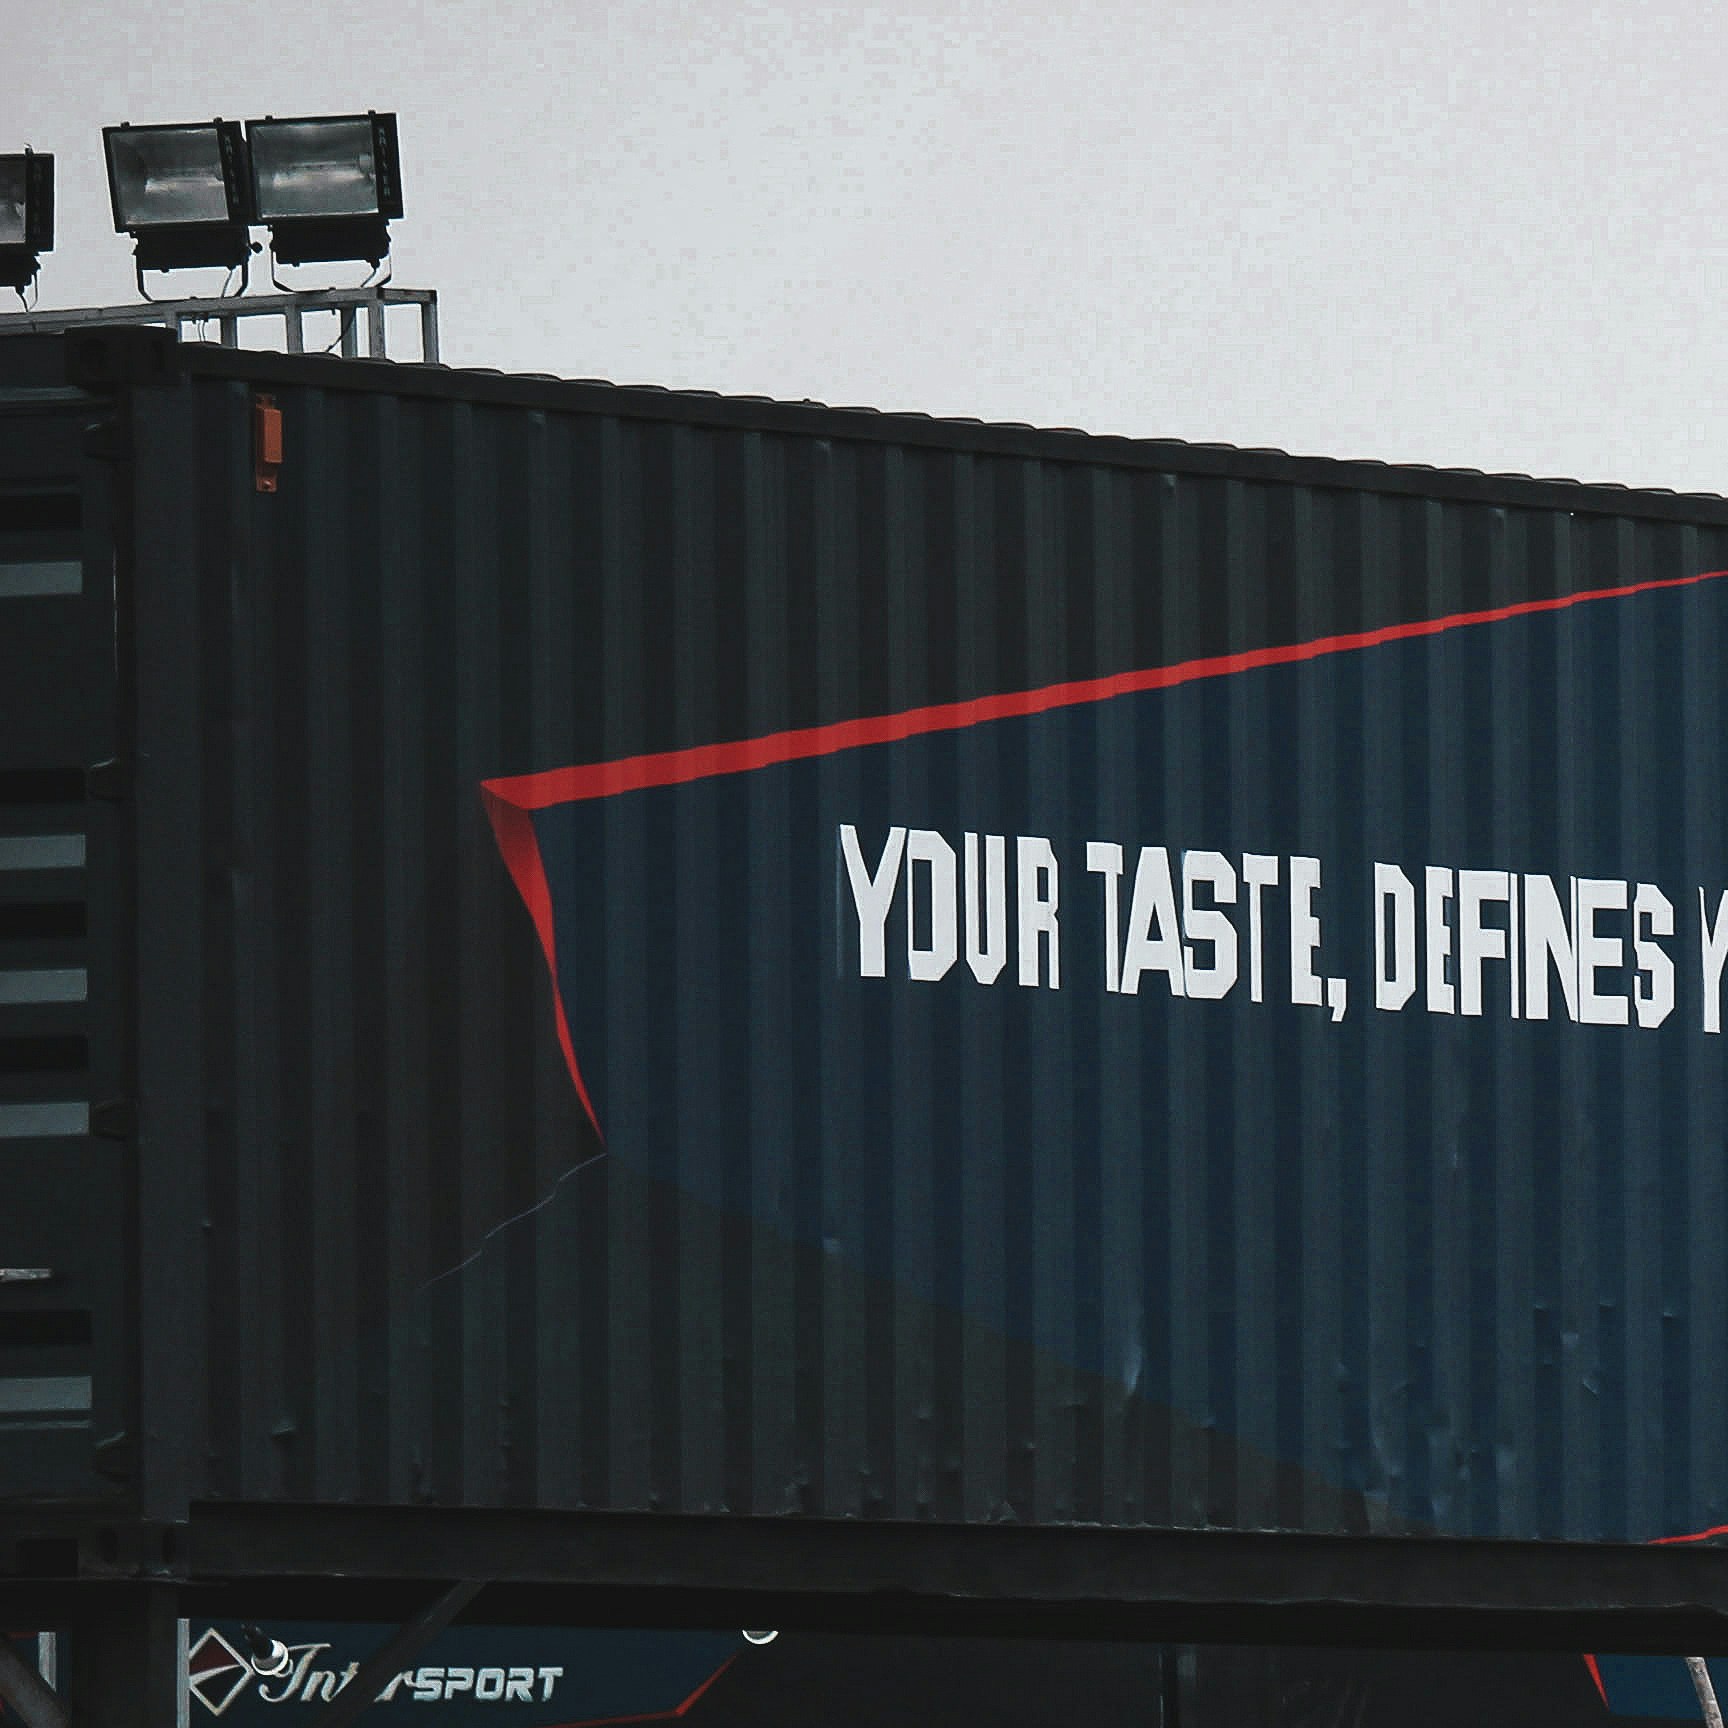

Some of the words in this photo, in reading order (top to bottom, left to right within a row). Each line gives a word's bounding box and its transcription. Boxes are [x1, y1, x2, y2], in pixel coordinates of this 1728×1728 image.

[840, 823, 1060, 990] YOUR
[1086, 842, 1347, 1022] TASTE,
[1374, 861, 1675, 1030] DEFINES
